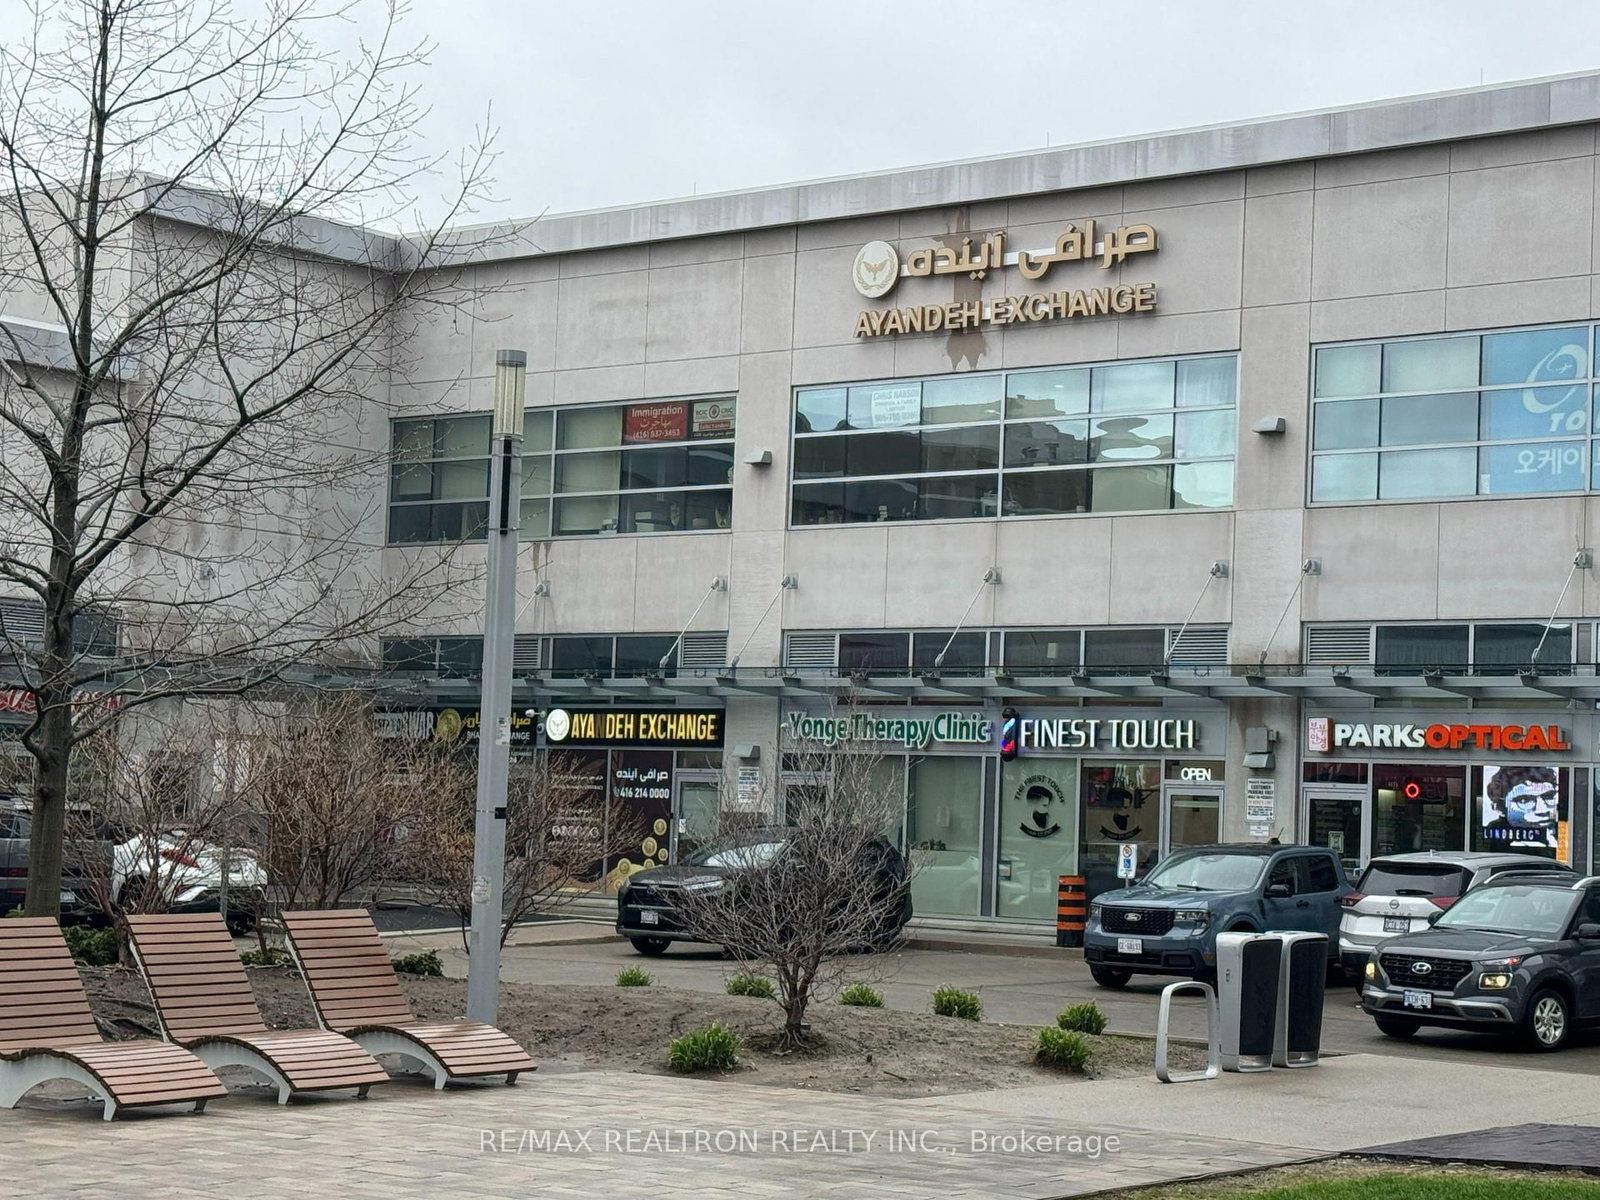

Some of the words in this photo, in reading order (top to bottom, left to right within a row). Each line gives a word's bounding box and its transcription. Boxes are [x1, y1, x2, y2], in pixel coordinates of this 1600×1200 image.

[1018, 220, 1158, 279] صرافی
[853, 301, 981, 338] AYANDEH
[990, 283, 1156, 325] EXCHANGE
[632, 405, 682, 418] Immigration
[1549, 410, 1600, 432] TO
[510, 731, 530, 740] ANGE
[639, 714, 717, 740] EXCHANGE
[788, 712, 847, 746] Yonge
[850, 713, 931, 748] Therapy
[933, 712, 993, 742] Clinic
[1020, 719, 1100, 748] FINEST
[1107, 719, 1196, 748] TOUCH
[1181, 767, 1212, 780] OPEN
[620, 786, 634, 798] 416
[634, 787, 648, 798] 214
[649, 788, 670, 799] 0000
[1013, 784, 1025, 801] THE
[1046, 777, 1065, 803] TOUCH
[1484, 828, 1534, 840] LINDBERG
